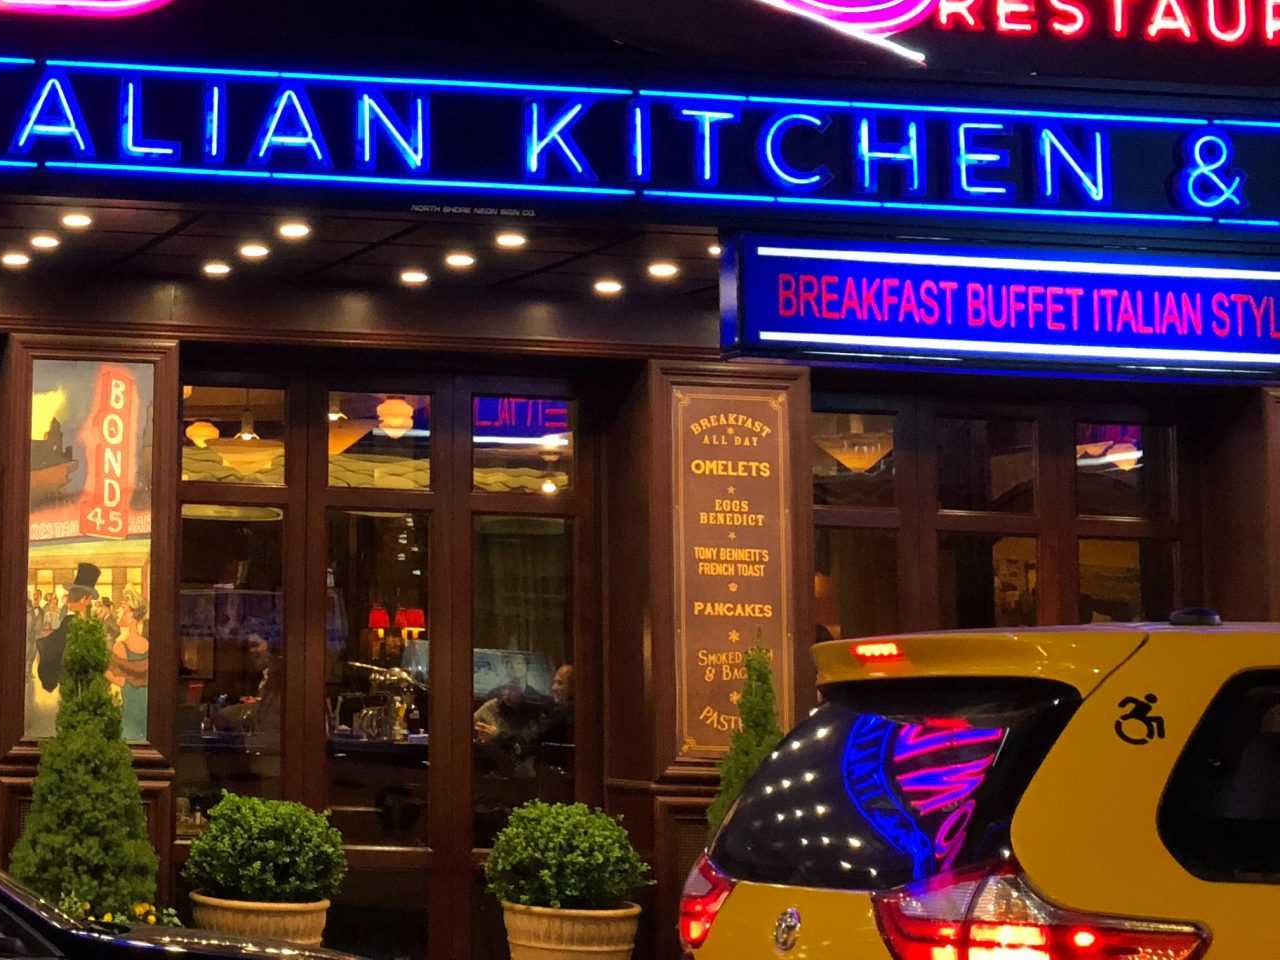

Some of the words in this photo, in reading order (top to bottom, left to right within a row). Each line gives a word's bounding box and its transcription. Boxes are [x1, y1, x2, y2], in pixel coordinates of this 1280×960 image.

[524, 98, 1108, 204] KITCHEN
[1185, 133, 1243, 209] &
[777, 273, 959, 326] BREAKFAST
[966, 282, 1084, 332] BUFFET
[1091, 287, 1202, 336] ITALIAN
[689, 413, 772, 438] BREAKFAST
[101, 378, 126, 509] BOND
[702, 434, 728, 445] ALL
[734, 436, 759, 446] DAY
[690, 460, 771, 478] OMELETS
[714, 499, 749, 513] EGGS
[86, 507, 124, 533] 45
[699, 512, 765, 526] BENEDICT
[694, 546, 718, 560] TONY
[719, 547, 769, 562] BENNETT'S
[698, 562, 735, 576] FRENCH
[737, 563, 765, 577] TOAST
[693, 601, 773, 618] PANCAKES
[722, 665, 748, 681] BAG
